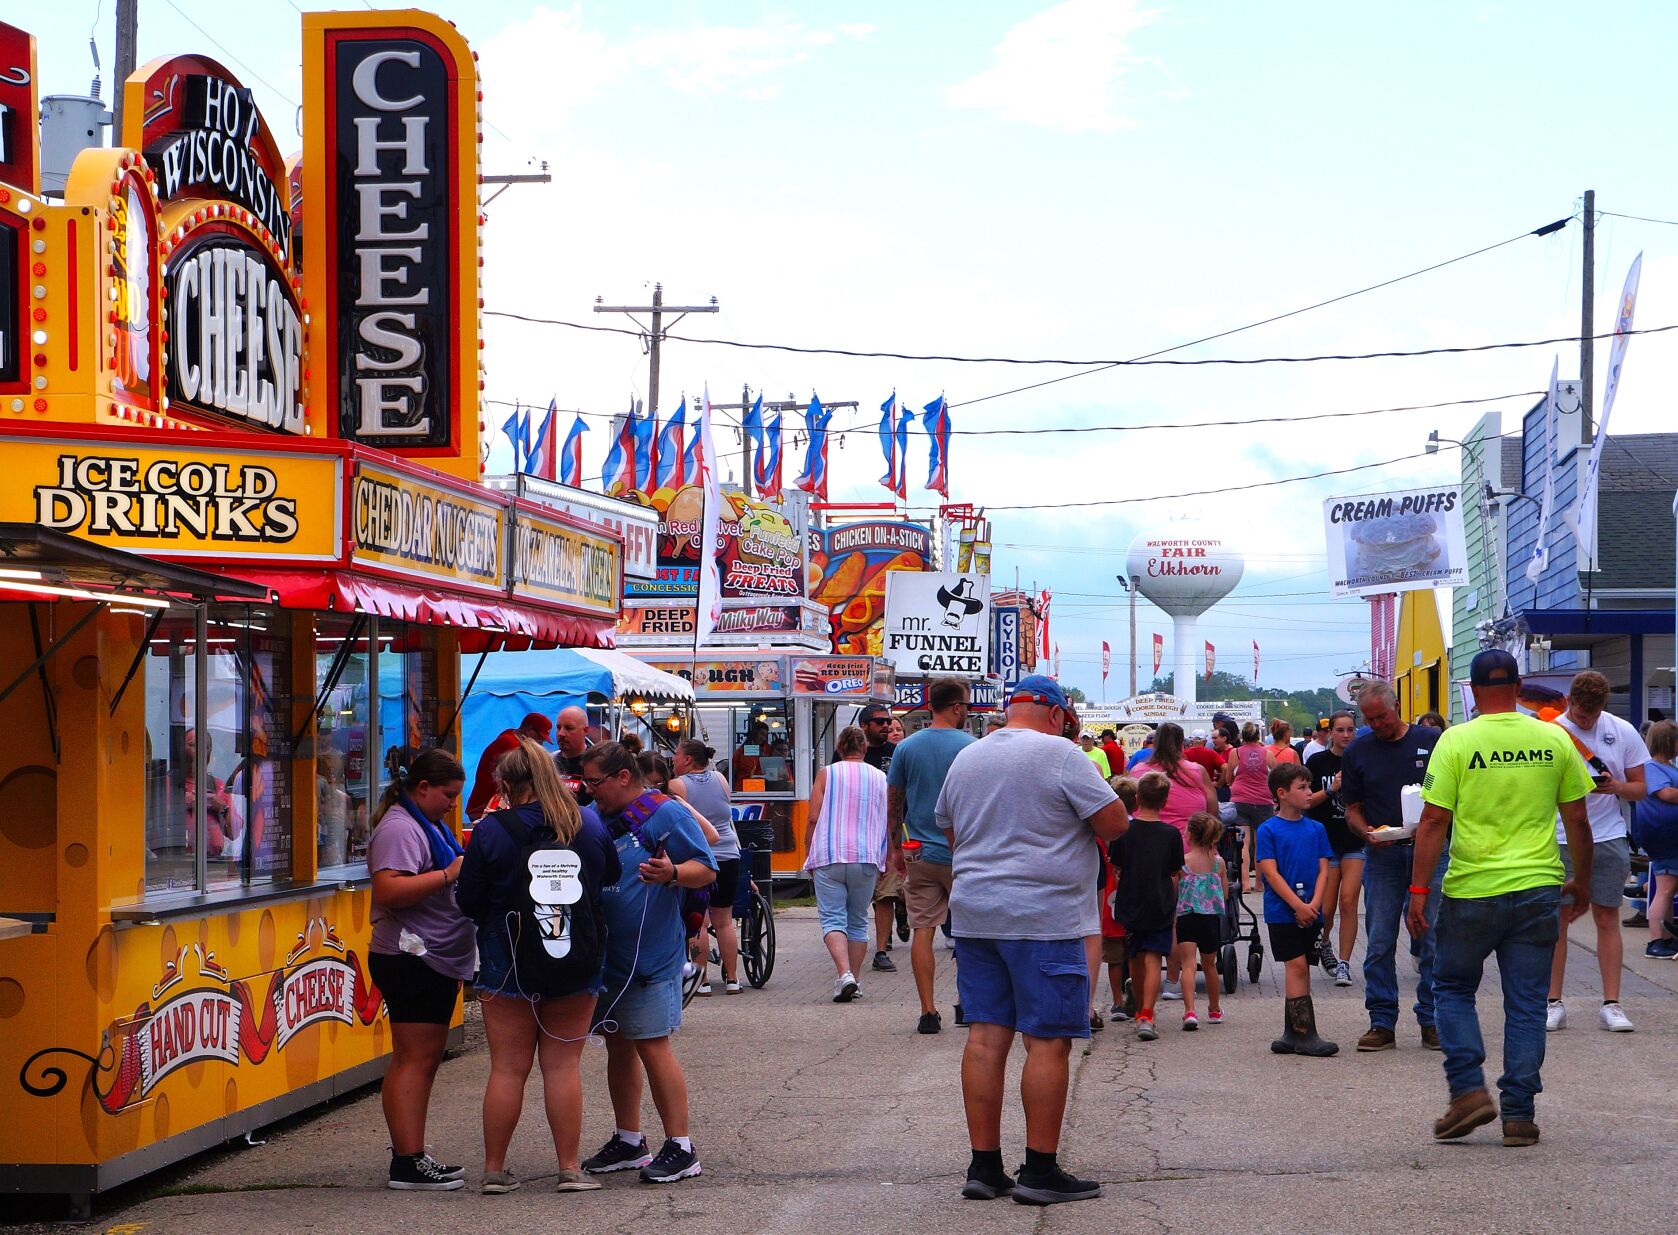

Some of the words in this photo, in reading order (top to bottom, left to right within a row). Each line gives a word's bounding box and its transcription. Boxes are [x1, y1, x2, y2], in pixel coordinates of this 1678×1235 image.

[205, 75, 260, 147] HOT
[162, 130, 292, 256] WISCONSIN
[352, 51, 431, 436] CHEESE
[176, 248, 304, 433] CHEESE
[58, 454, 140, 495] ICE
[144, 460, 277, 500] COLD
[34, 485, 299, 544] DRINKS
[1330, 498, 1393, 524] CREAM
[1400, 491, 1457, 516] PUFFS
[354, 476, 433, 565] CHEDDAR
[434, 498, 498, 579] NUGGETS
[669, 520, 698, 536] Red
[834, 526, 873, 551] CHICKEN
[874, 526, 924, 551] ON-A-STICK
[742, 538, 775, 559] Cake
[776, 548, 801, 569] Pop
[1147, 540, 1190, 548] WALWORTH
[1162, 547, 1207, 558] FAIR
[732, 560, 761, 574] Deep
[761, 563, 793, 577] Fried
[1147, 558, 1222, 578] Elkhorn
[724, 573, 799, 595] TREATS
[644, 609, 690, 621] DEEP
[902, 616, 931, 632] mr.
[641, 621, 693, 633] FRIED
[889, 634, 982, 653] FUNNEL
[1002, 614, 1014, 681] GYROS
[918, 654, 982, 672] CAKE
[825, 678, 864, 693] OREO
[1131, 704, 1155, 712] COOKIE
[1490, 749, 1553, 762] ADAMS
[284, 967, 346, 1031] CHEESE
[150, 1001, 197, 1075] HAND
[199, 998, 231, 1052] CUT
